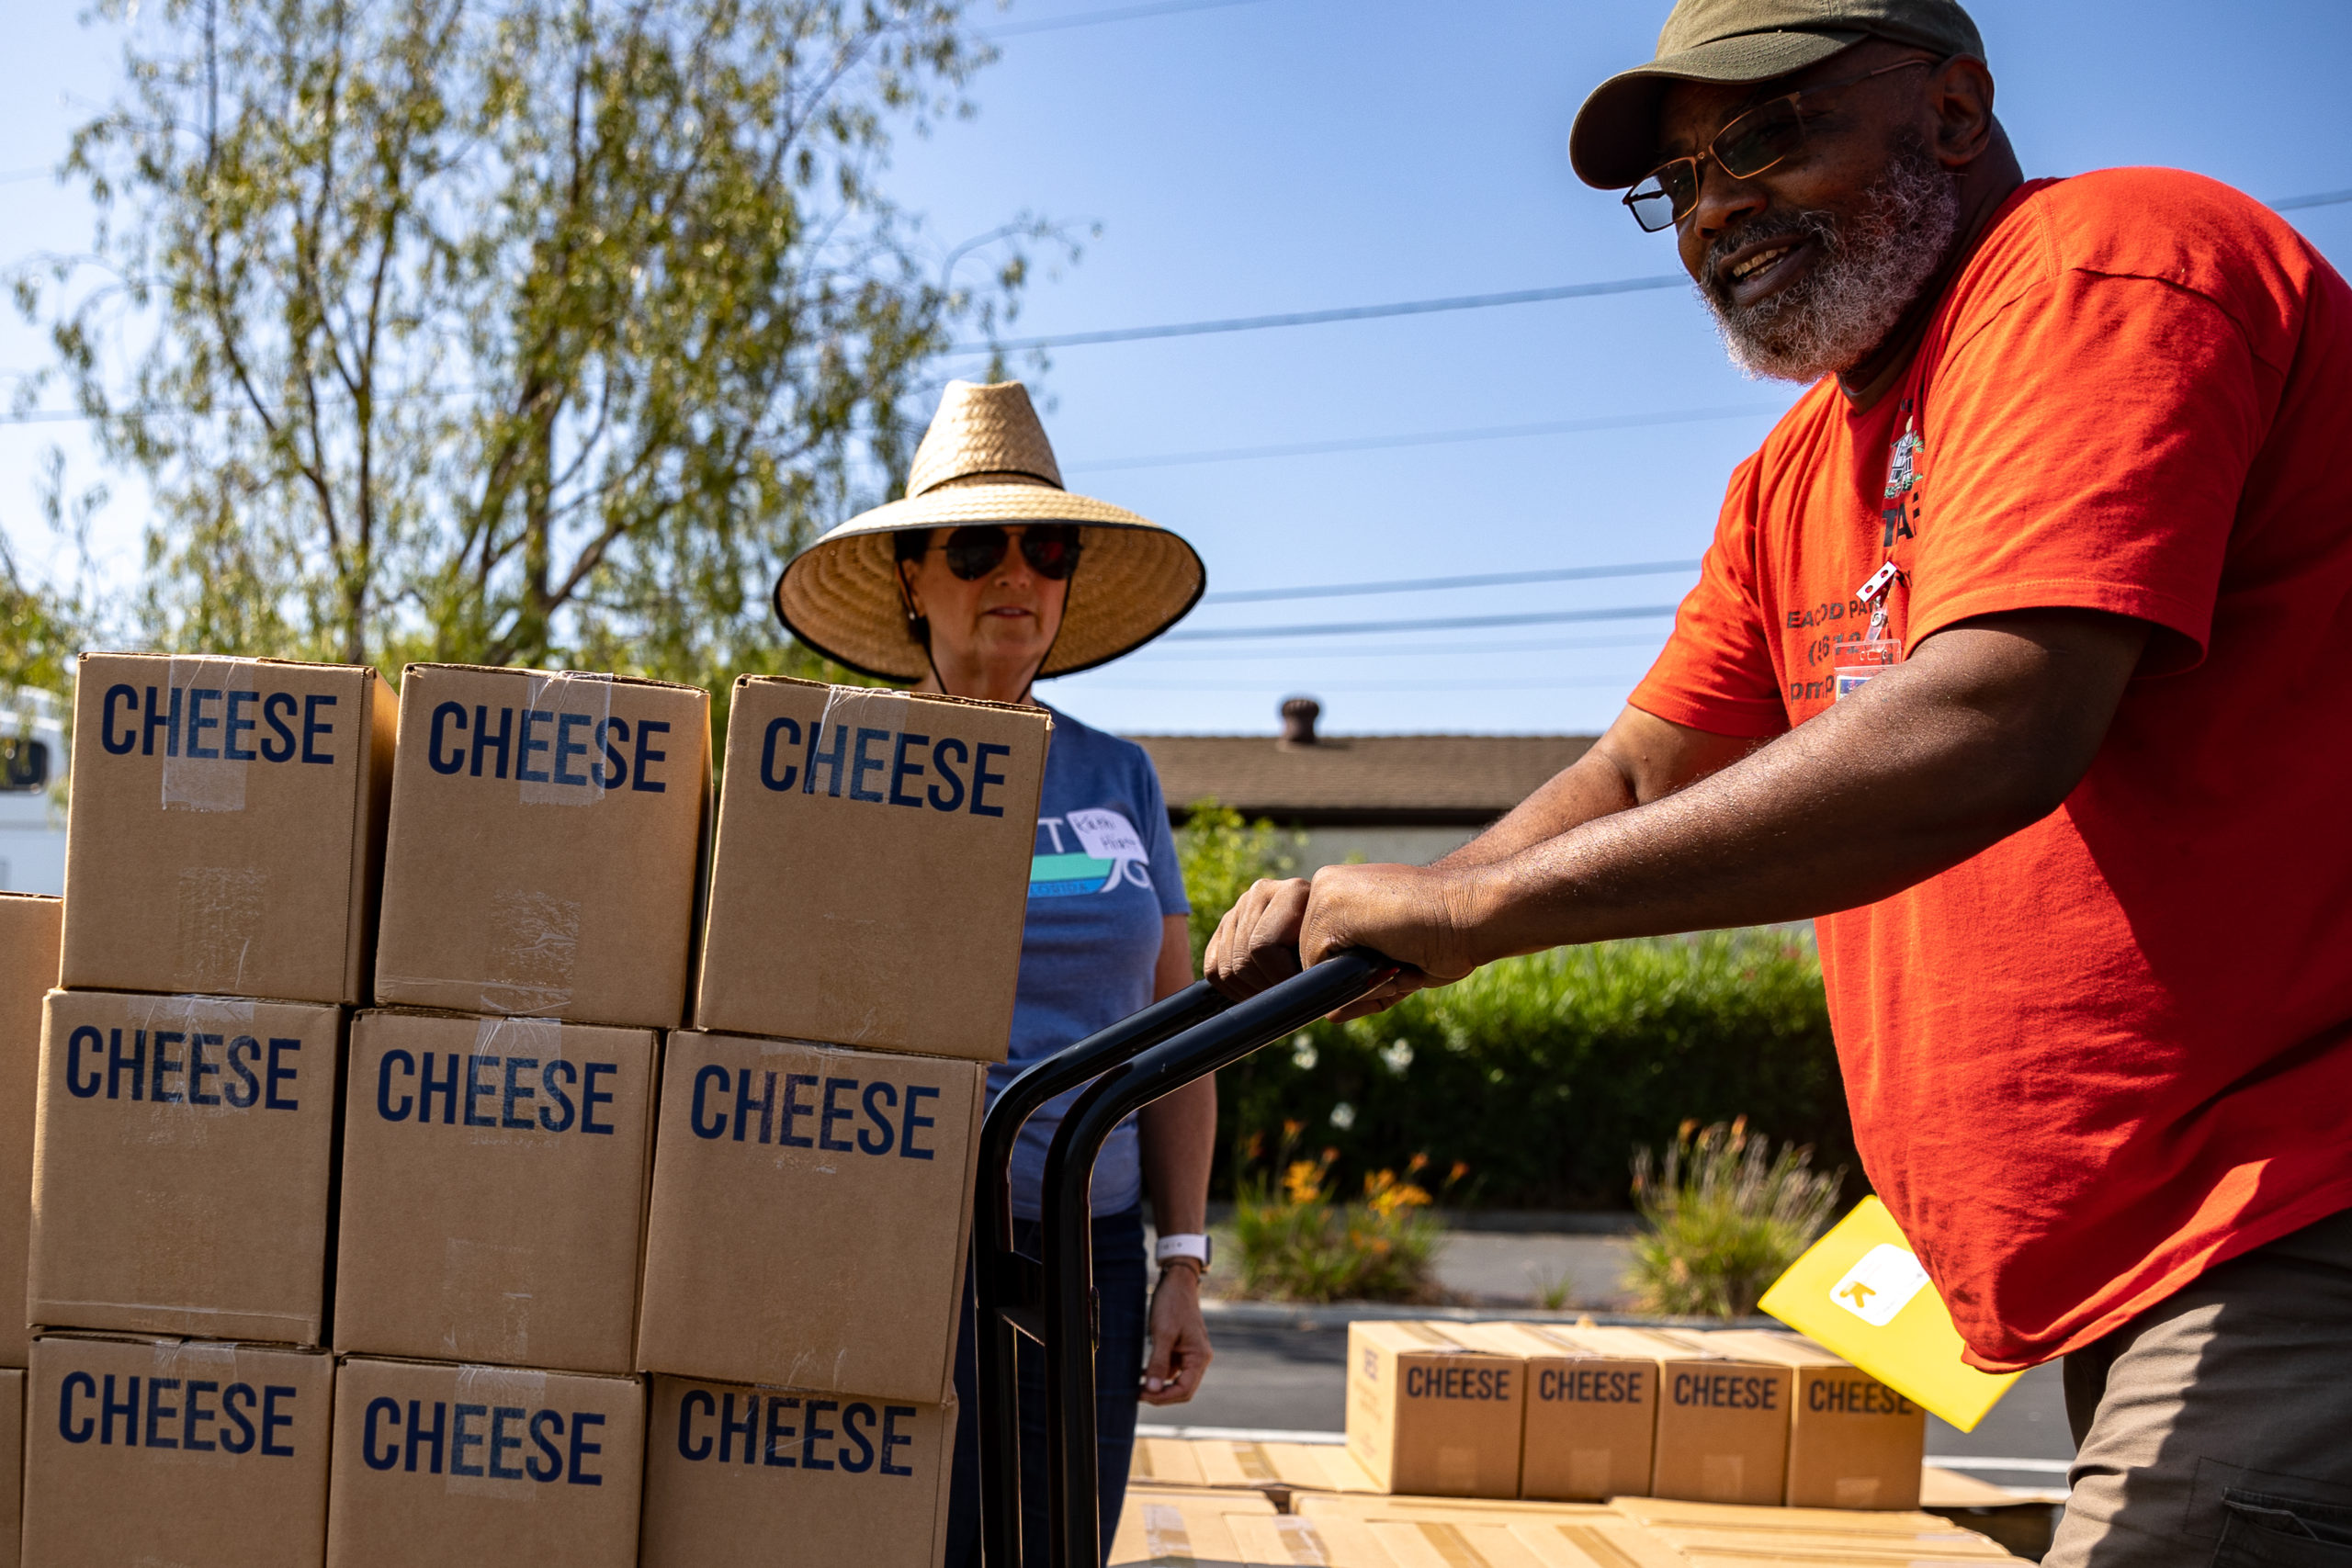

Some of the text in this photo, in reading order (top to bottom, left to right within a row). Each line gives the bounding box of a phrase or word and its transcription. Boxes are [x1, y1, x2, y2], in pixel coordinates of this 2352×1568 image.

[101, 683, 337, 764] CHEESE
[428, 701, 671, 794] CHEESE
[760, 716, 1011, 818] CHEESE
[66, 1025, 301, 1111] CHEESE
[377, 1048, 617, 1135] CHEESE
[690, 1064, 940, 1160] CHEESE
[59, 1371, 297, 1457] CHEESE
[1407, 1366, 1510, 1401] CHEESE
[1539, 1370, 1643, 1404] CHEESE
[1674, 1373, 1778, 1410] CHEESE
[362, 1396, 605, 1485] CHEESE
[677, 1389, 916, 1476] CHEESE
